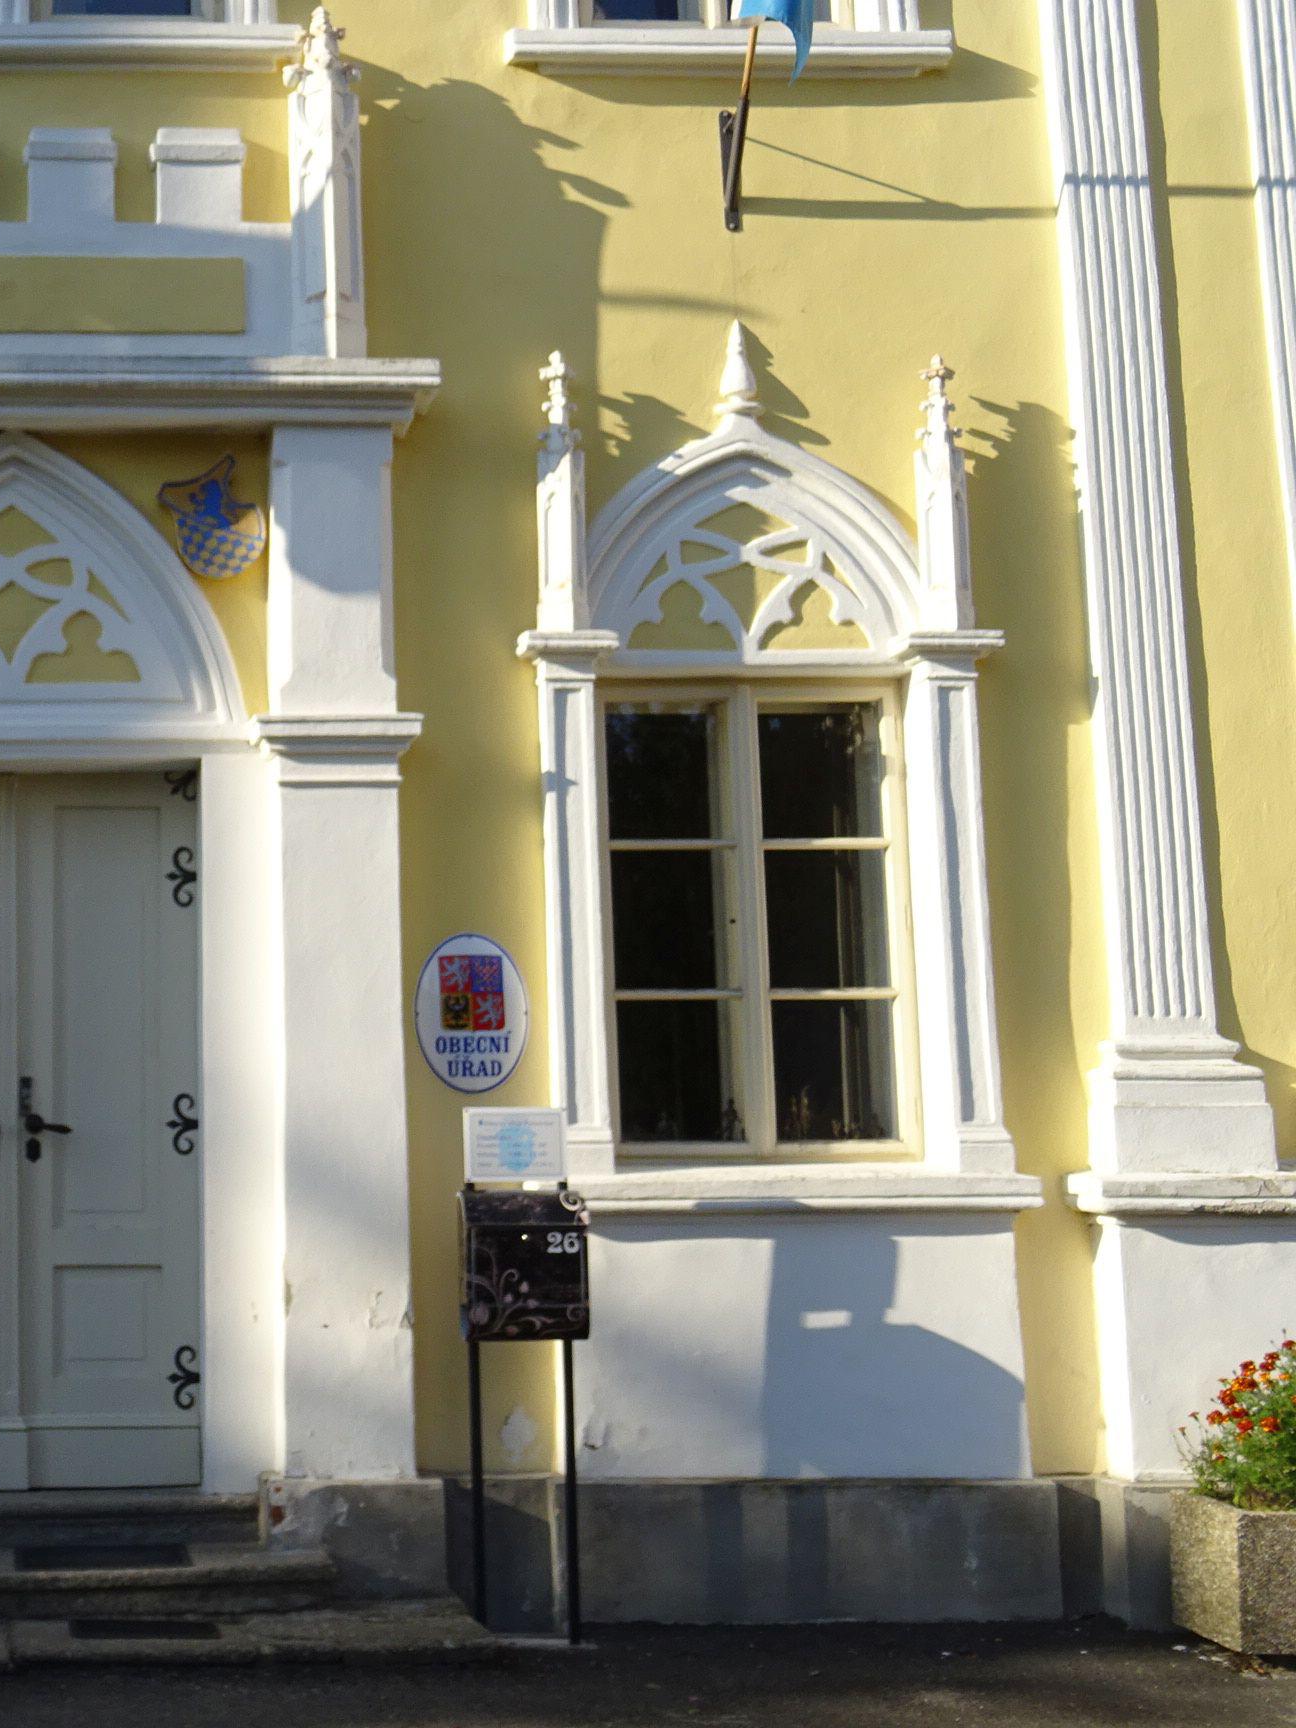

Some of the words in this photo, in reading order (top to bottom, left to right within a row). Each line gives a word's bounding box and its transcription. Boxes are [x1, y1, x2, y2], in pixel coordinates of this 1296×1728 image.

[435, 1030, 512, 1054] OBECNÍ
[447, 1054, 502, 1077] ÚŘAD
[546, 1231, 580, 1254] 26
